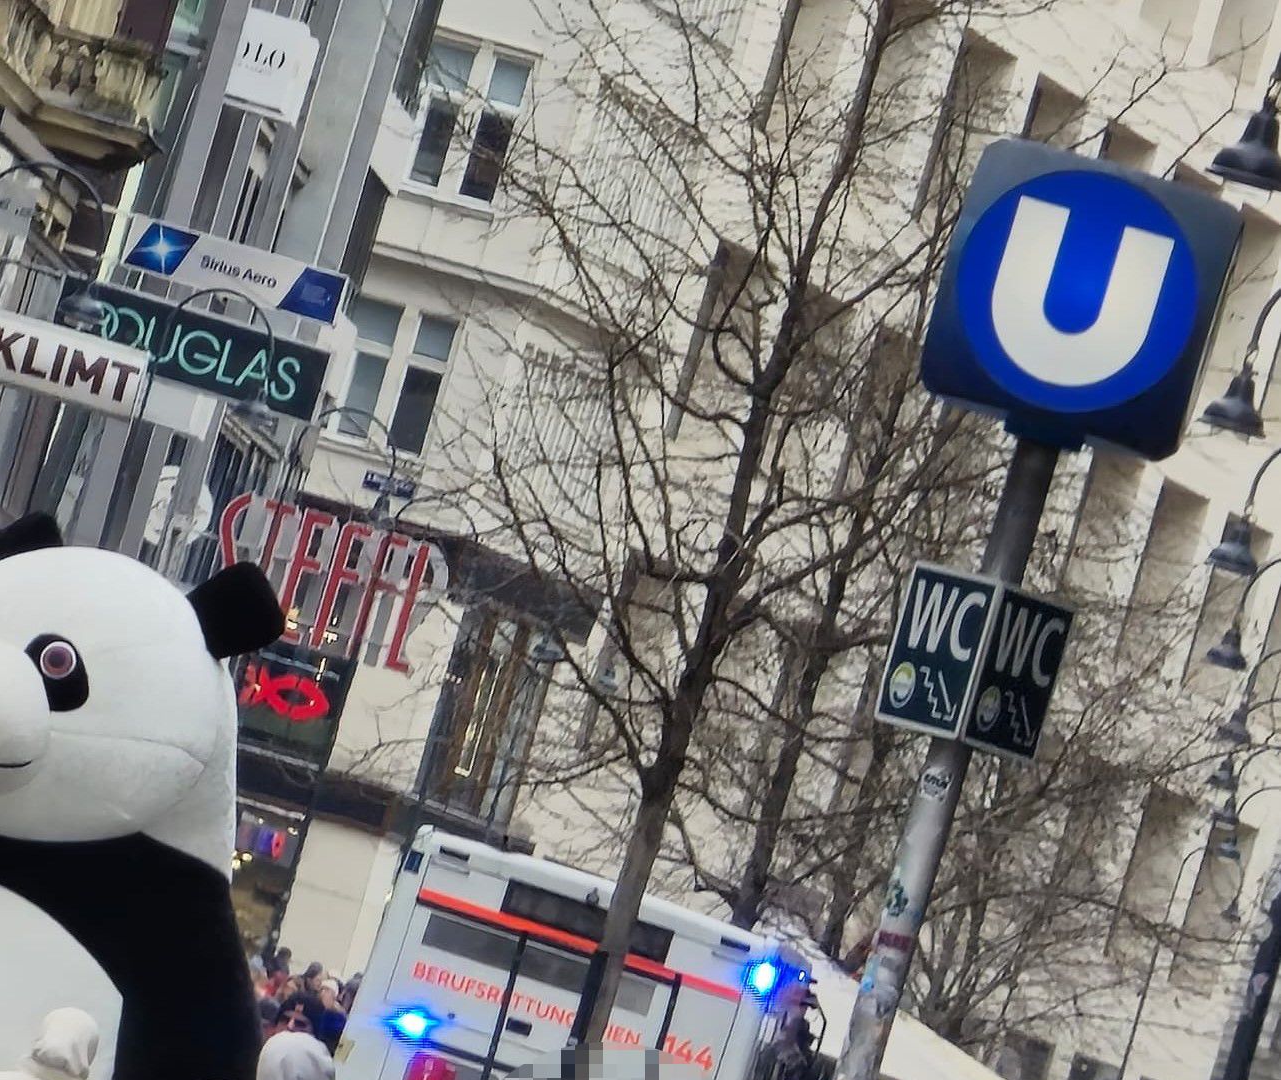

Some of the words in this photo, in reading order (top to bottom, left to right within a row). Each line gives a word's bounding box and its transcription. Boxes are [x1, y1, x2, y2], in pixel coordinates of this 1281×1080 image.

[200, 254, 241, 278] Sirius
[241, 267, 278, 289] Aero
[991, 195, 1175, 388] U
[907, 578, 988, 663] WC
[994, 601, 1066, 689] WC
[603, 1022, 643, 1047] IEN
[663, 1033, 714, 1072] 144
